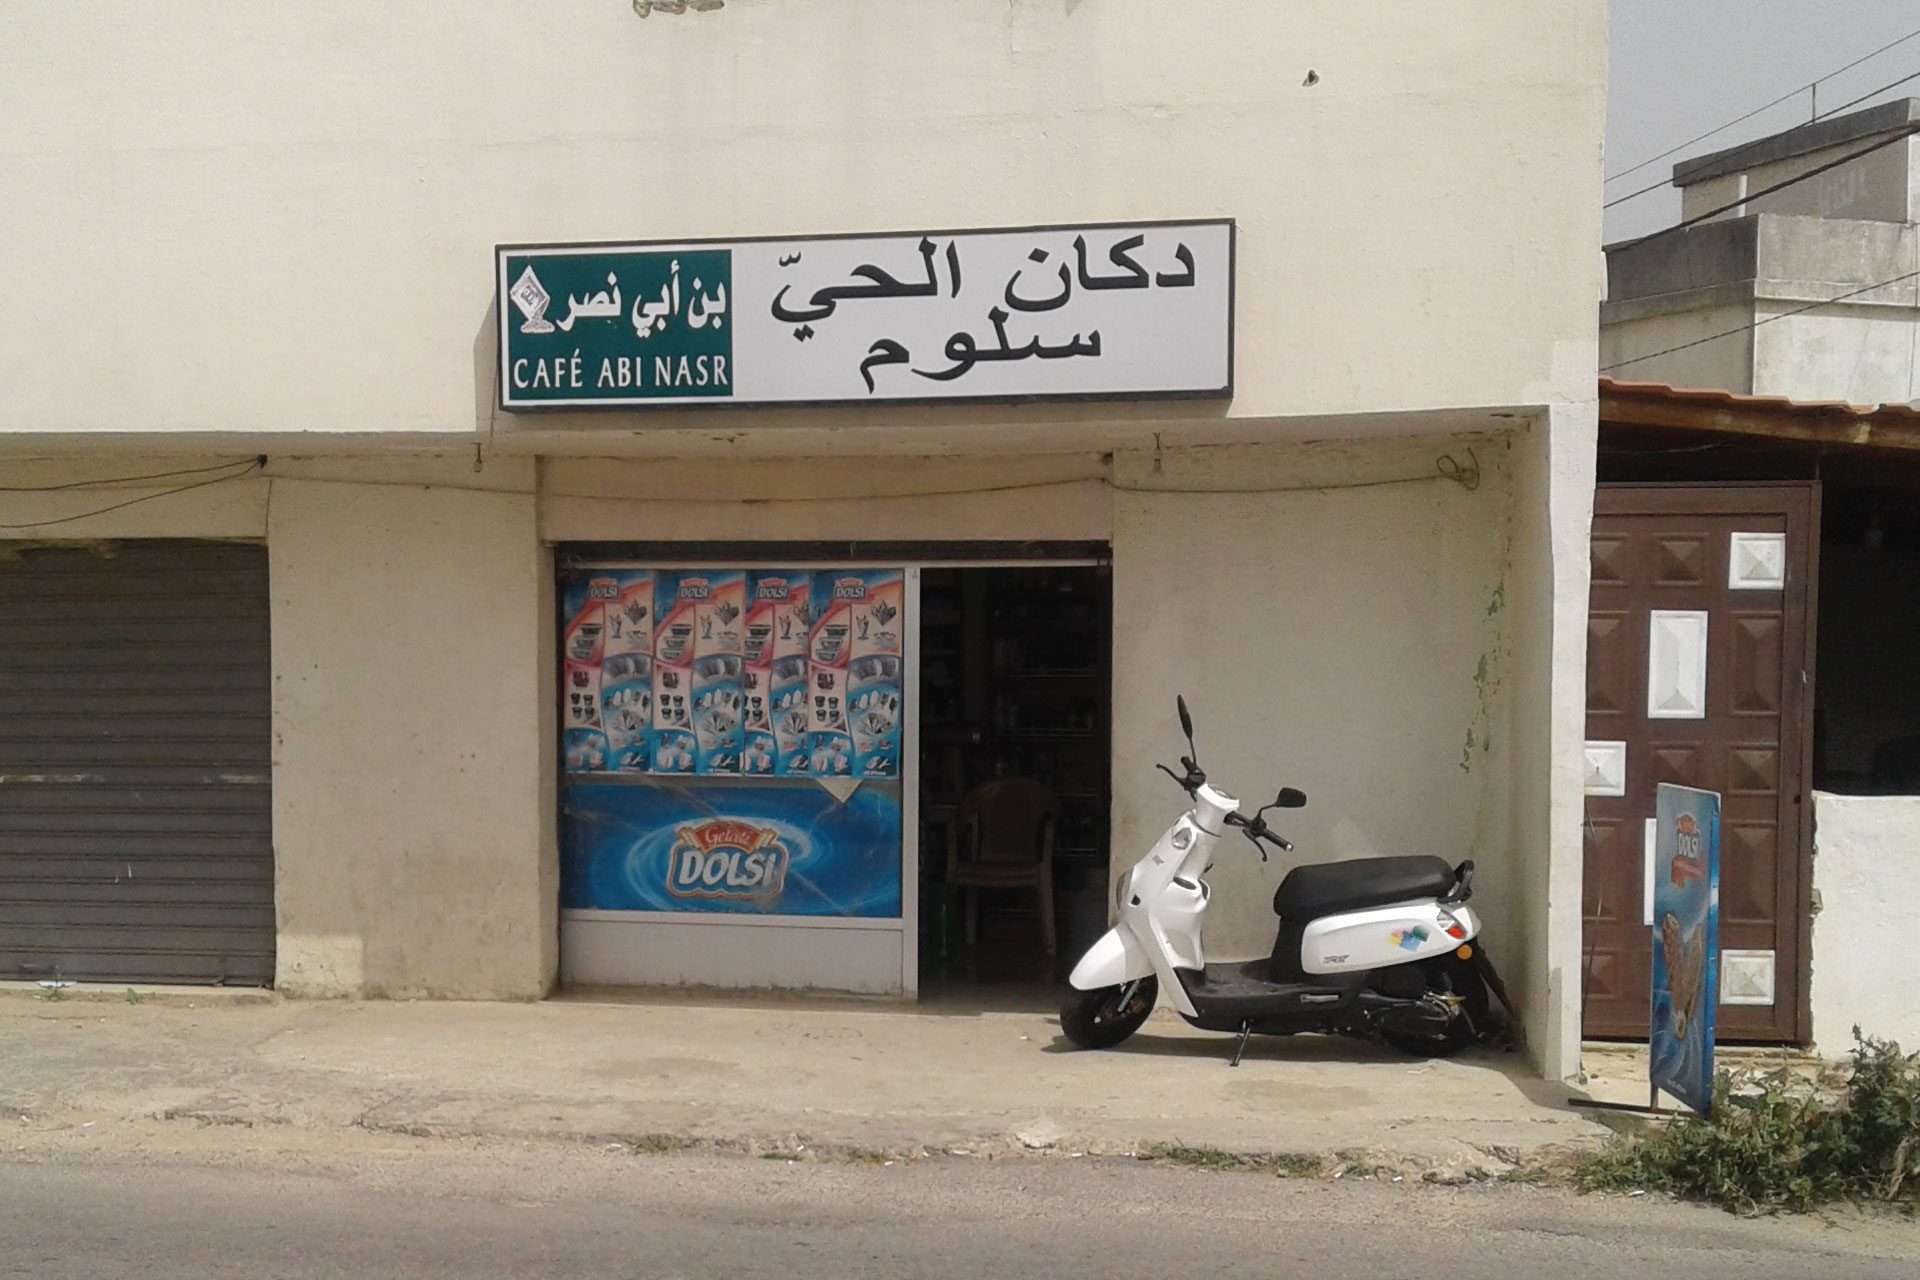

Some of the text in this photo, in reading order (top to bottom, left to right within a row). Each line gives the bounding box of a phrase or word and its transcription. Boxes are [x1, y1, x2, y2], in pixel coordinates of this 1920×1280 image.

[1004, 233, 1197, 313] دكان
[556, 259, 727, 338] بن أبي نصر
[513, 348, 729, 389] CAFÉ ABI NASR
[858, 307, 1101, 394] سلوم
[758, 586, 789, 598] DOLSI
[835, 586, 866, 598] DOLSI
[678, 850, 777, 887] DOLSI
